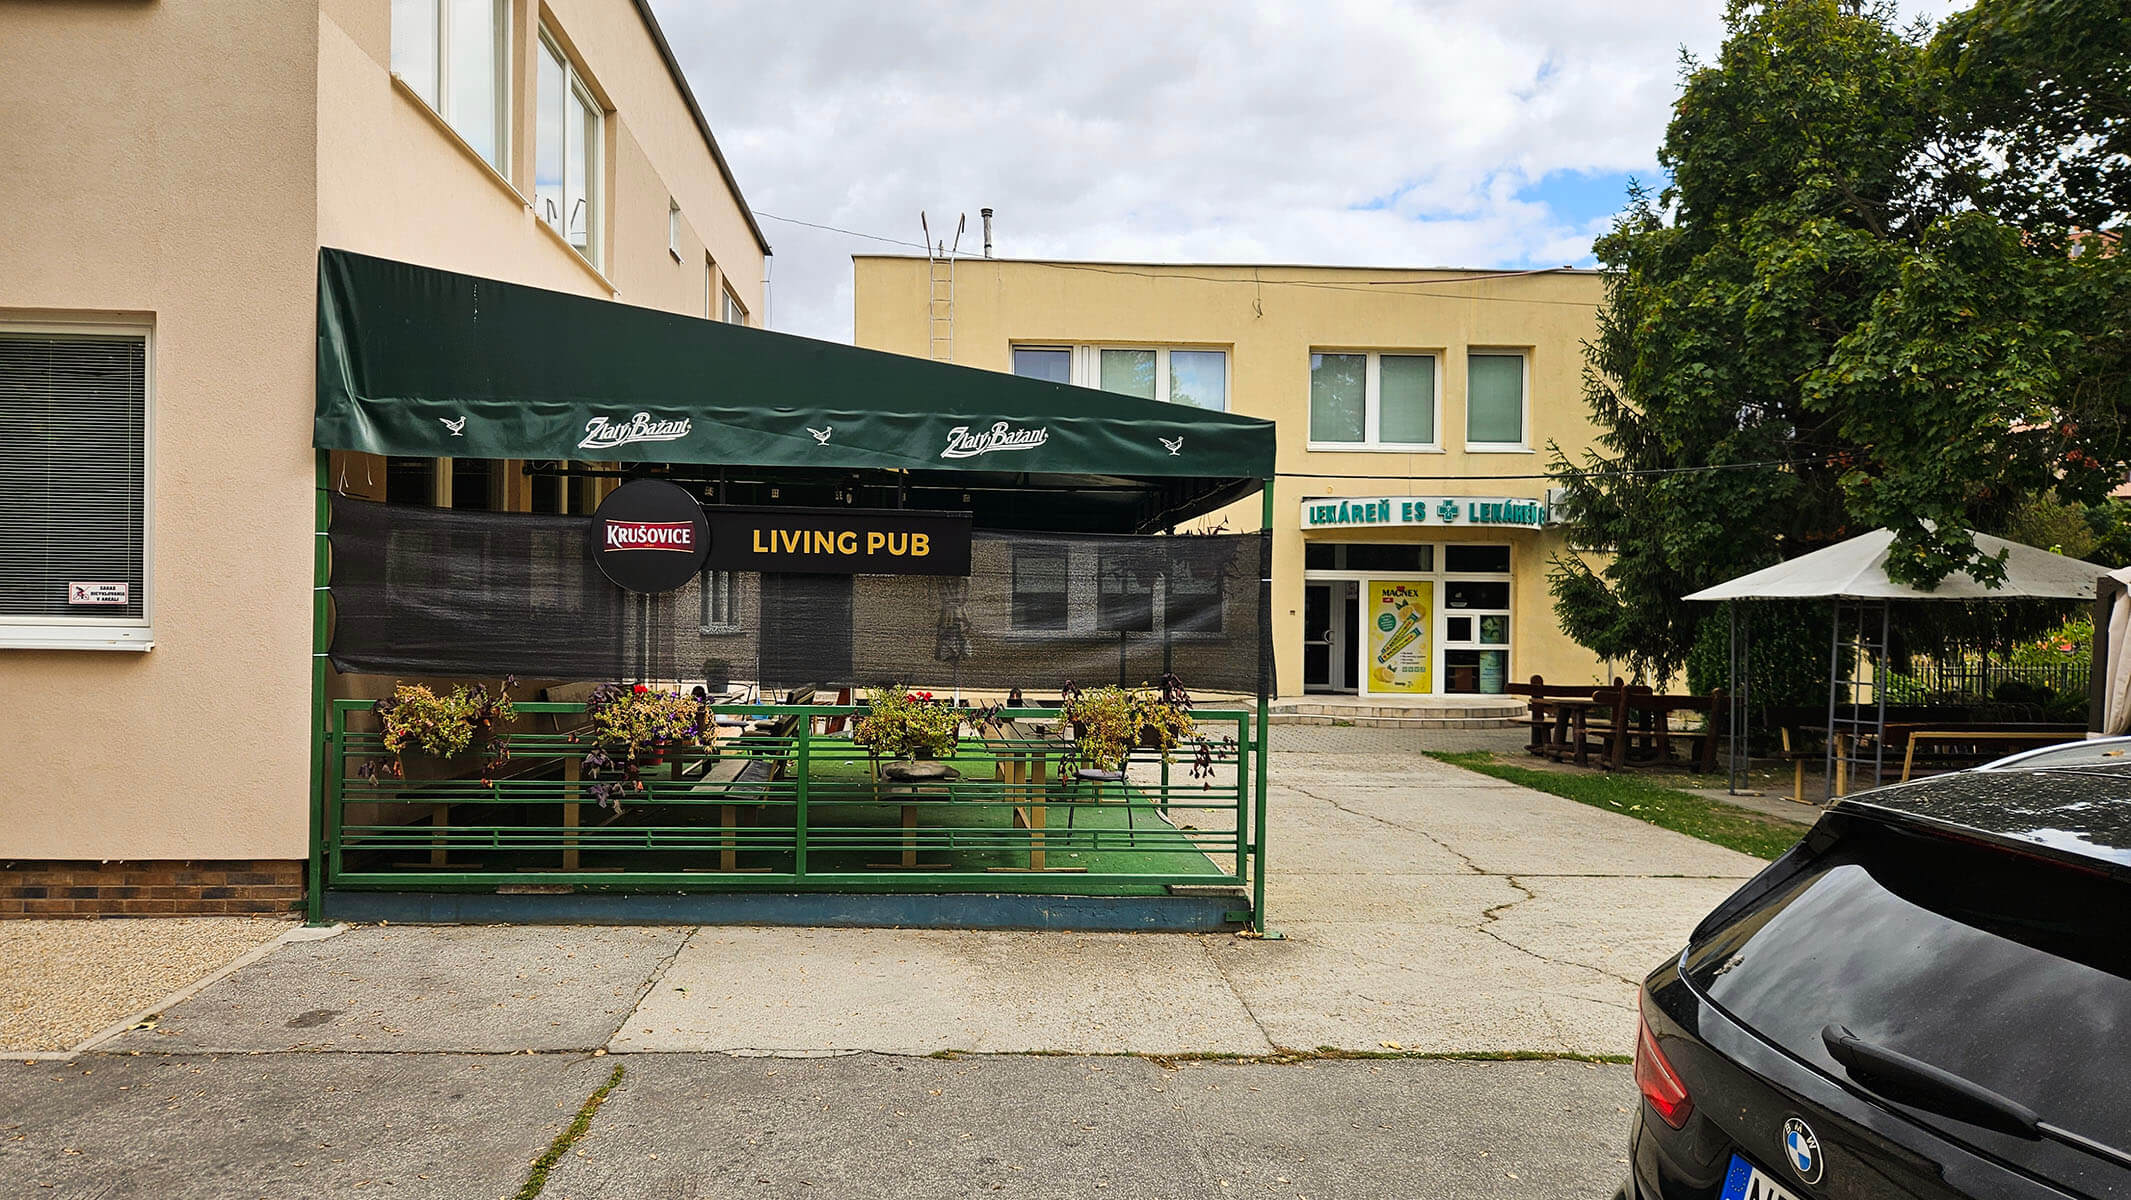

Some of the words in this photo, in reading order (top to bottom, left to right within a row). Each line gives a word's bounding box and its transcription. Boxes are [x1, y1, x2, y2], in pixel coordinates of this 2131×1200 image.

[577, 416, 632, 449] Zlatý
[627, 411, 692, 442] Bažant
[940, 426, 991, 458] Zlatý
[987, 421, 1049, 451] Bažant
[1309, 499, 1391, 524] LEKÁREŇ
[1402, 501, 1426, 522] ES
[1468, 499, 1538, 526] LEKÁREŇ
[753, 529, 857, 555] LIVING
[867, 531, 930, 556] PUB
[1784, 1121, 1817, 1150] BMW
